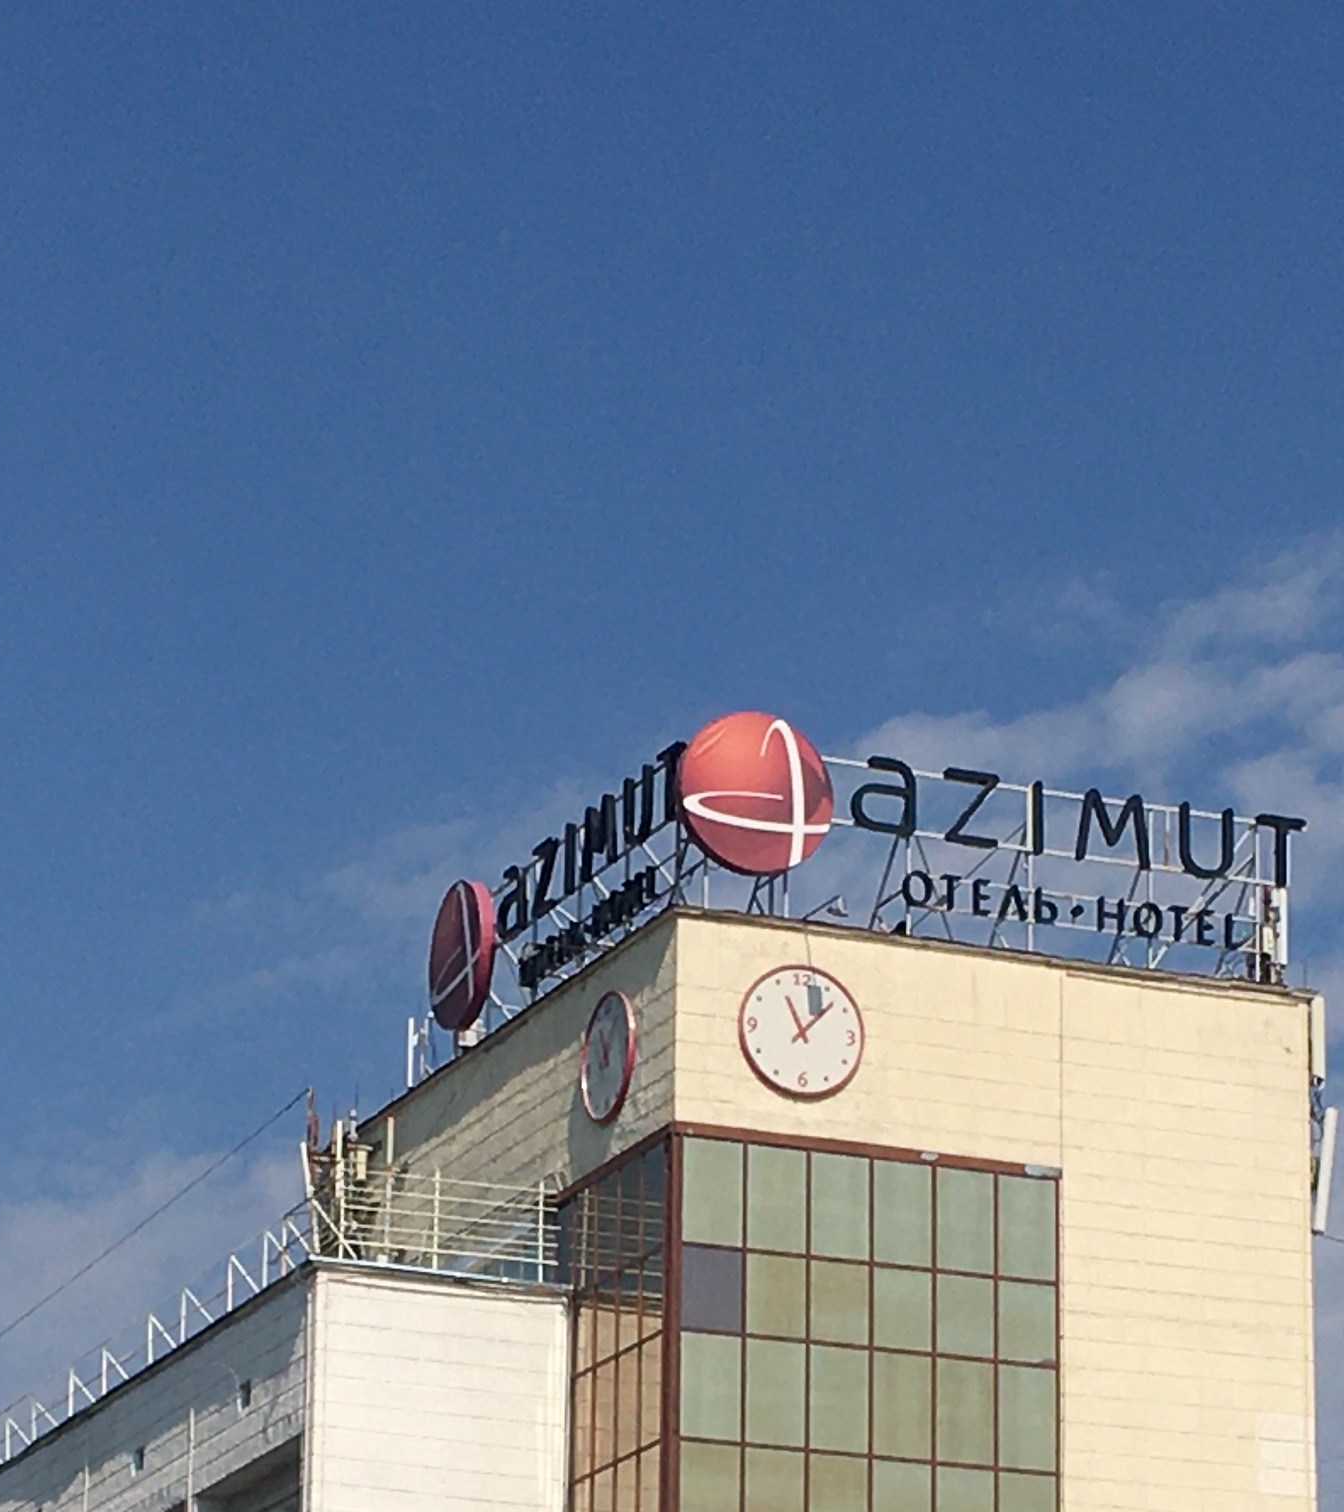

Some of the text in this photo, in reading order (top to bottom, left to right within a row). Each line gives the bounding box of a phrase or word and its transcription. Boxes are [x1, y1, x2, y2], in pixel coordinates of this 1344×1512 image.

[902, 869, 1059, 926] ОТЕЛЬ
[1096, 895, 1256, 950] HOTEL
[792, 973, 813, 987] 12
[747, 1016, 758, 1033] 9
[846, 1029, 856, 1047] 3
[797, 1071, 808, 1088] 6
